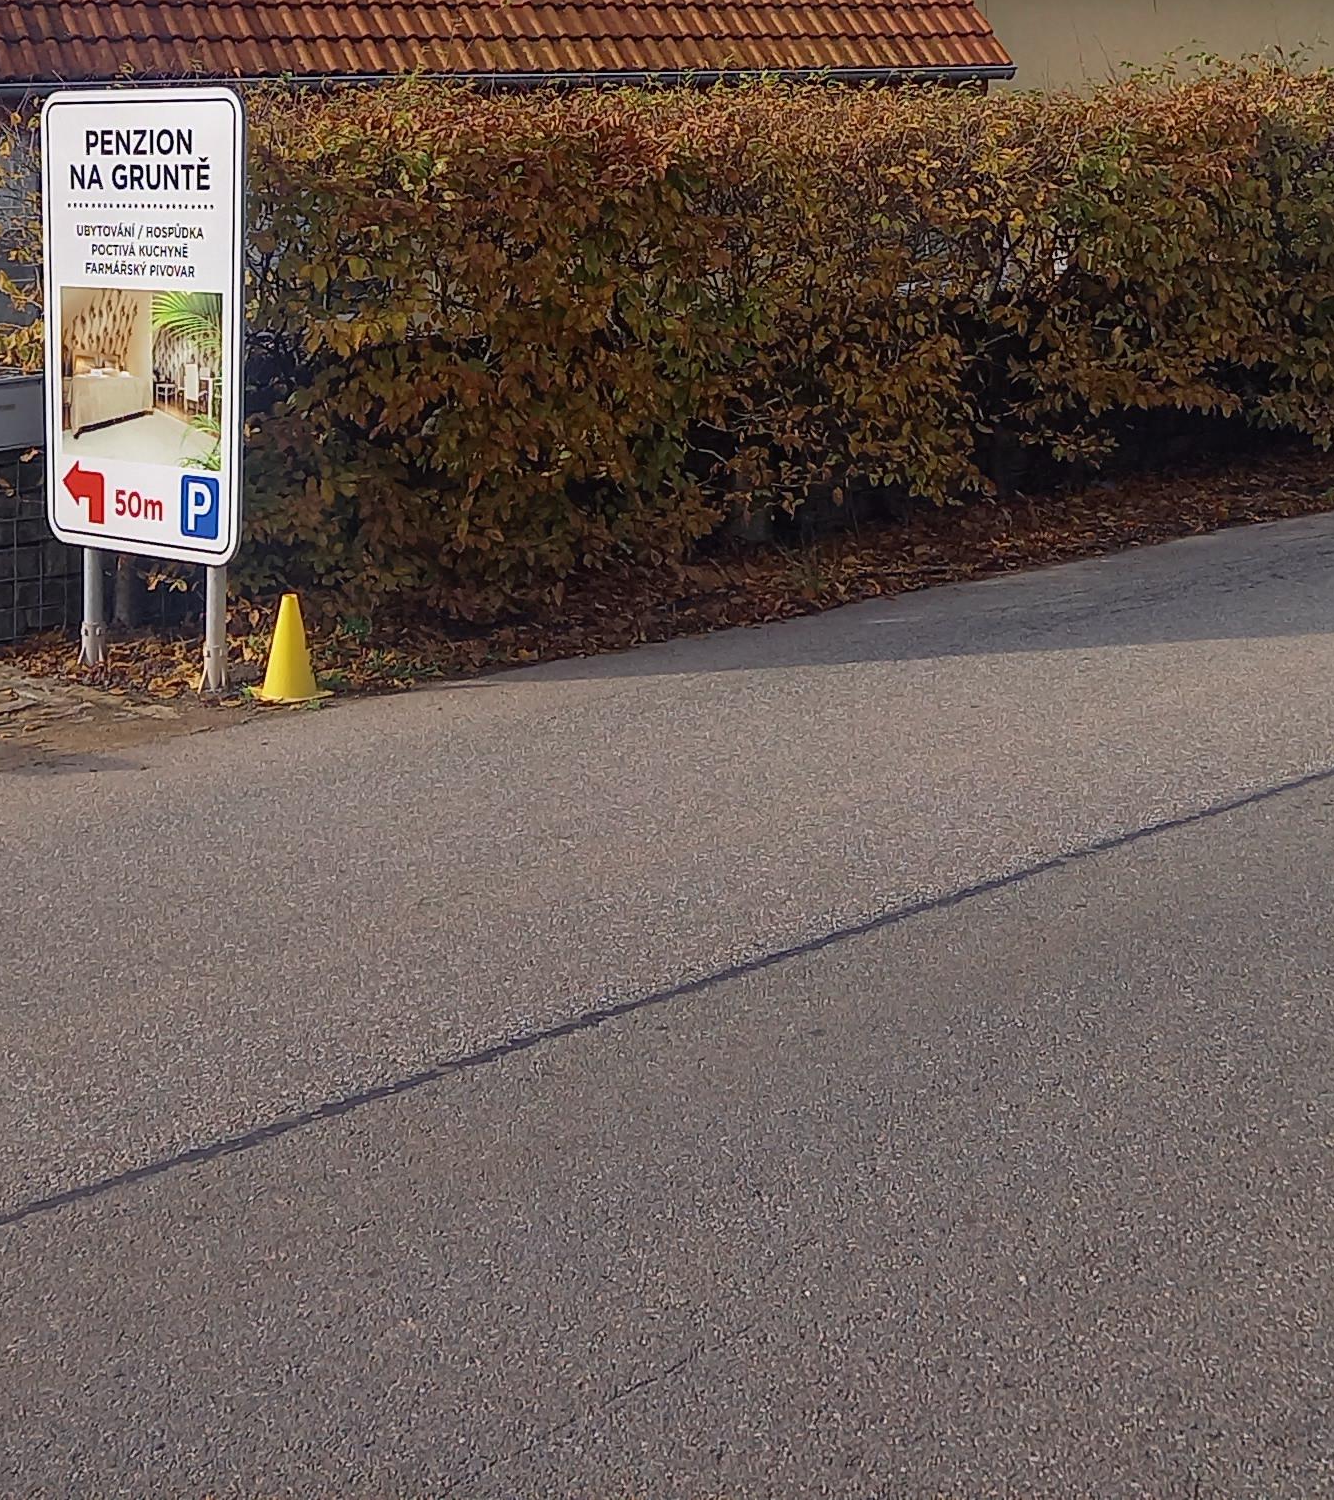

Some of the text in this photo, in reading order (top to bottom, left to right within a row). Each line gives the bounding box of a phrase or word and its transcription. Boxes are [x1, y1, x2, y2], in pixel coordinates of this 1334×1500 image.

[85, 128, 193, 156] PENZION
[70, 156, 210, 190] NA GRUNTĚ
[76, 222, 135, 238] UBYTOVÁNÍ
[146, 223, 204, 240] HOSPŮDKA
[91, 243, 189, 258] POCTIVÁ KUCHYNĚ
[85, 261, 195, 277] FARMÁŘSKÝ PIVOVAR
[115, 489, 163, 521] 50m
[187, 482, 212, 531] P
